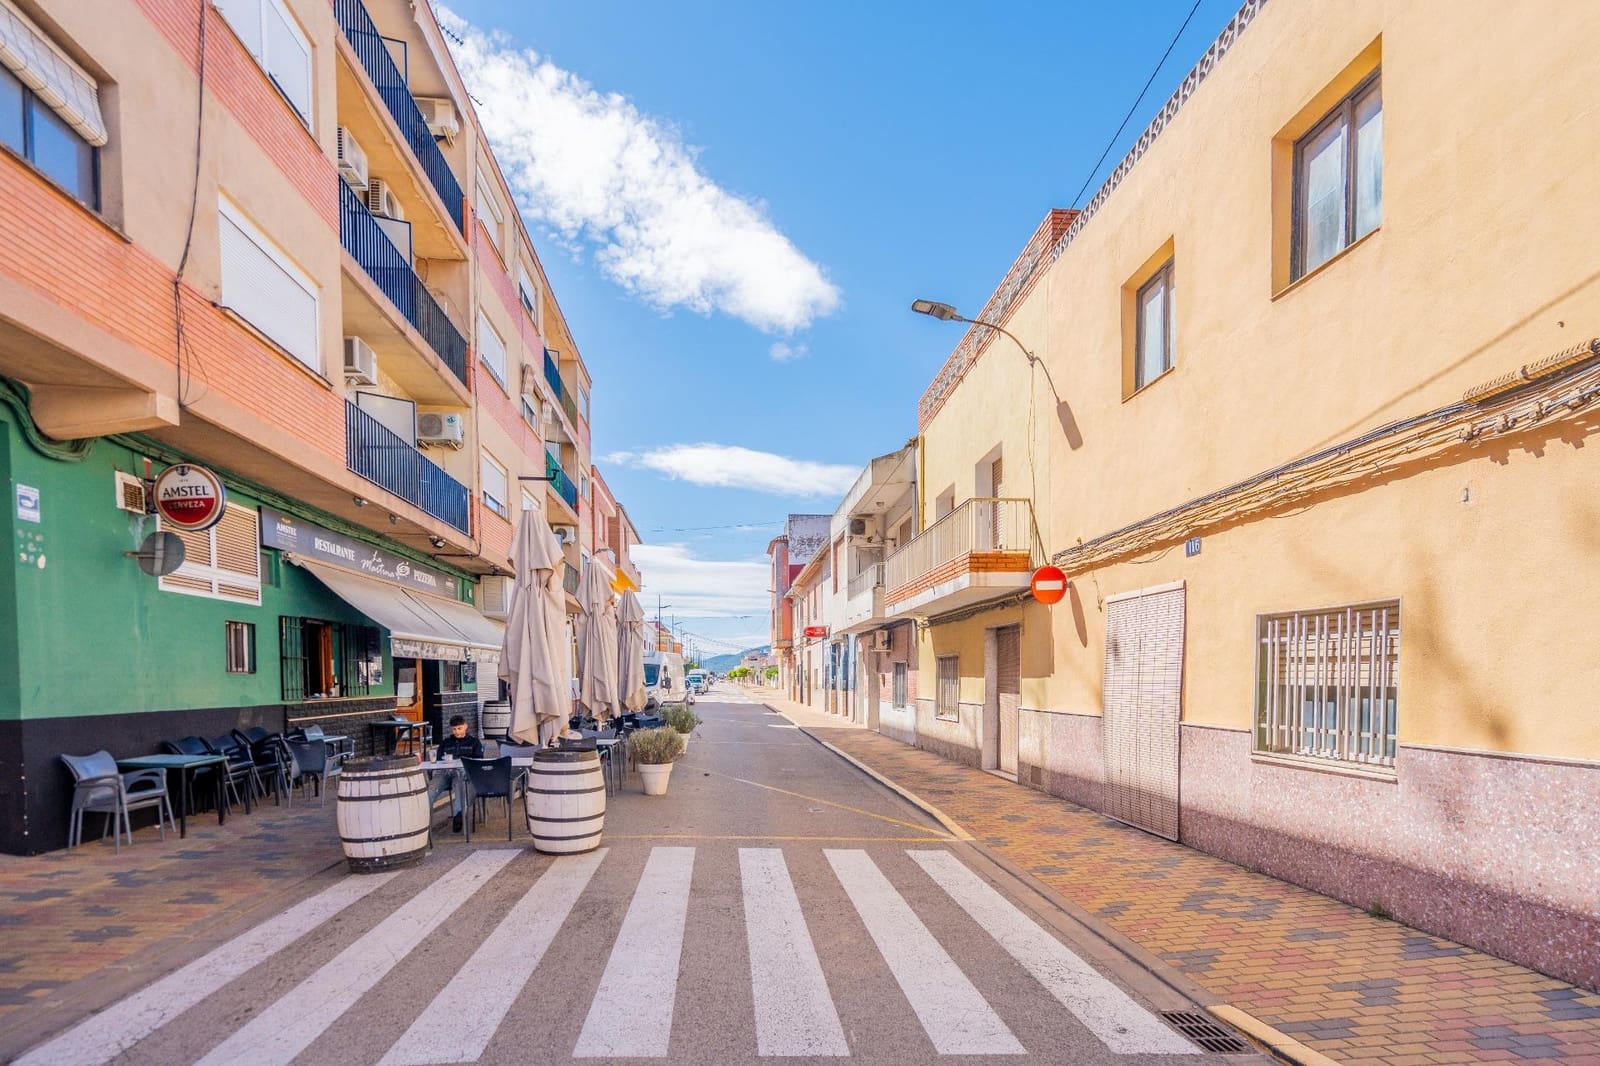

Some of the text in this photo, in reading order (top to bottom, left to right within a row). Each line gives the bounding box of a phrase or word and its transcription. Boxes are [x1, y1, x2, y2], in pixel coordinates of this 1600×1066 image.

[163, 485, 210, 498] AMSTEL
[168, 500, 206, 509] CERVEZA
[276, 522, 297, 536] AMSTEL
[314, 537, 356, 561] RESTAURANTE
[1188, 539, 1200, 555] 116
[413, 569, 437, 587] PIZZERIA
